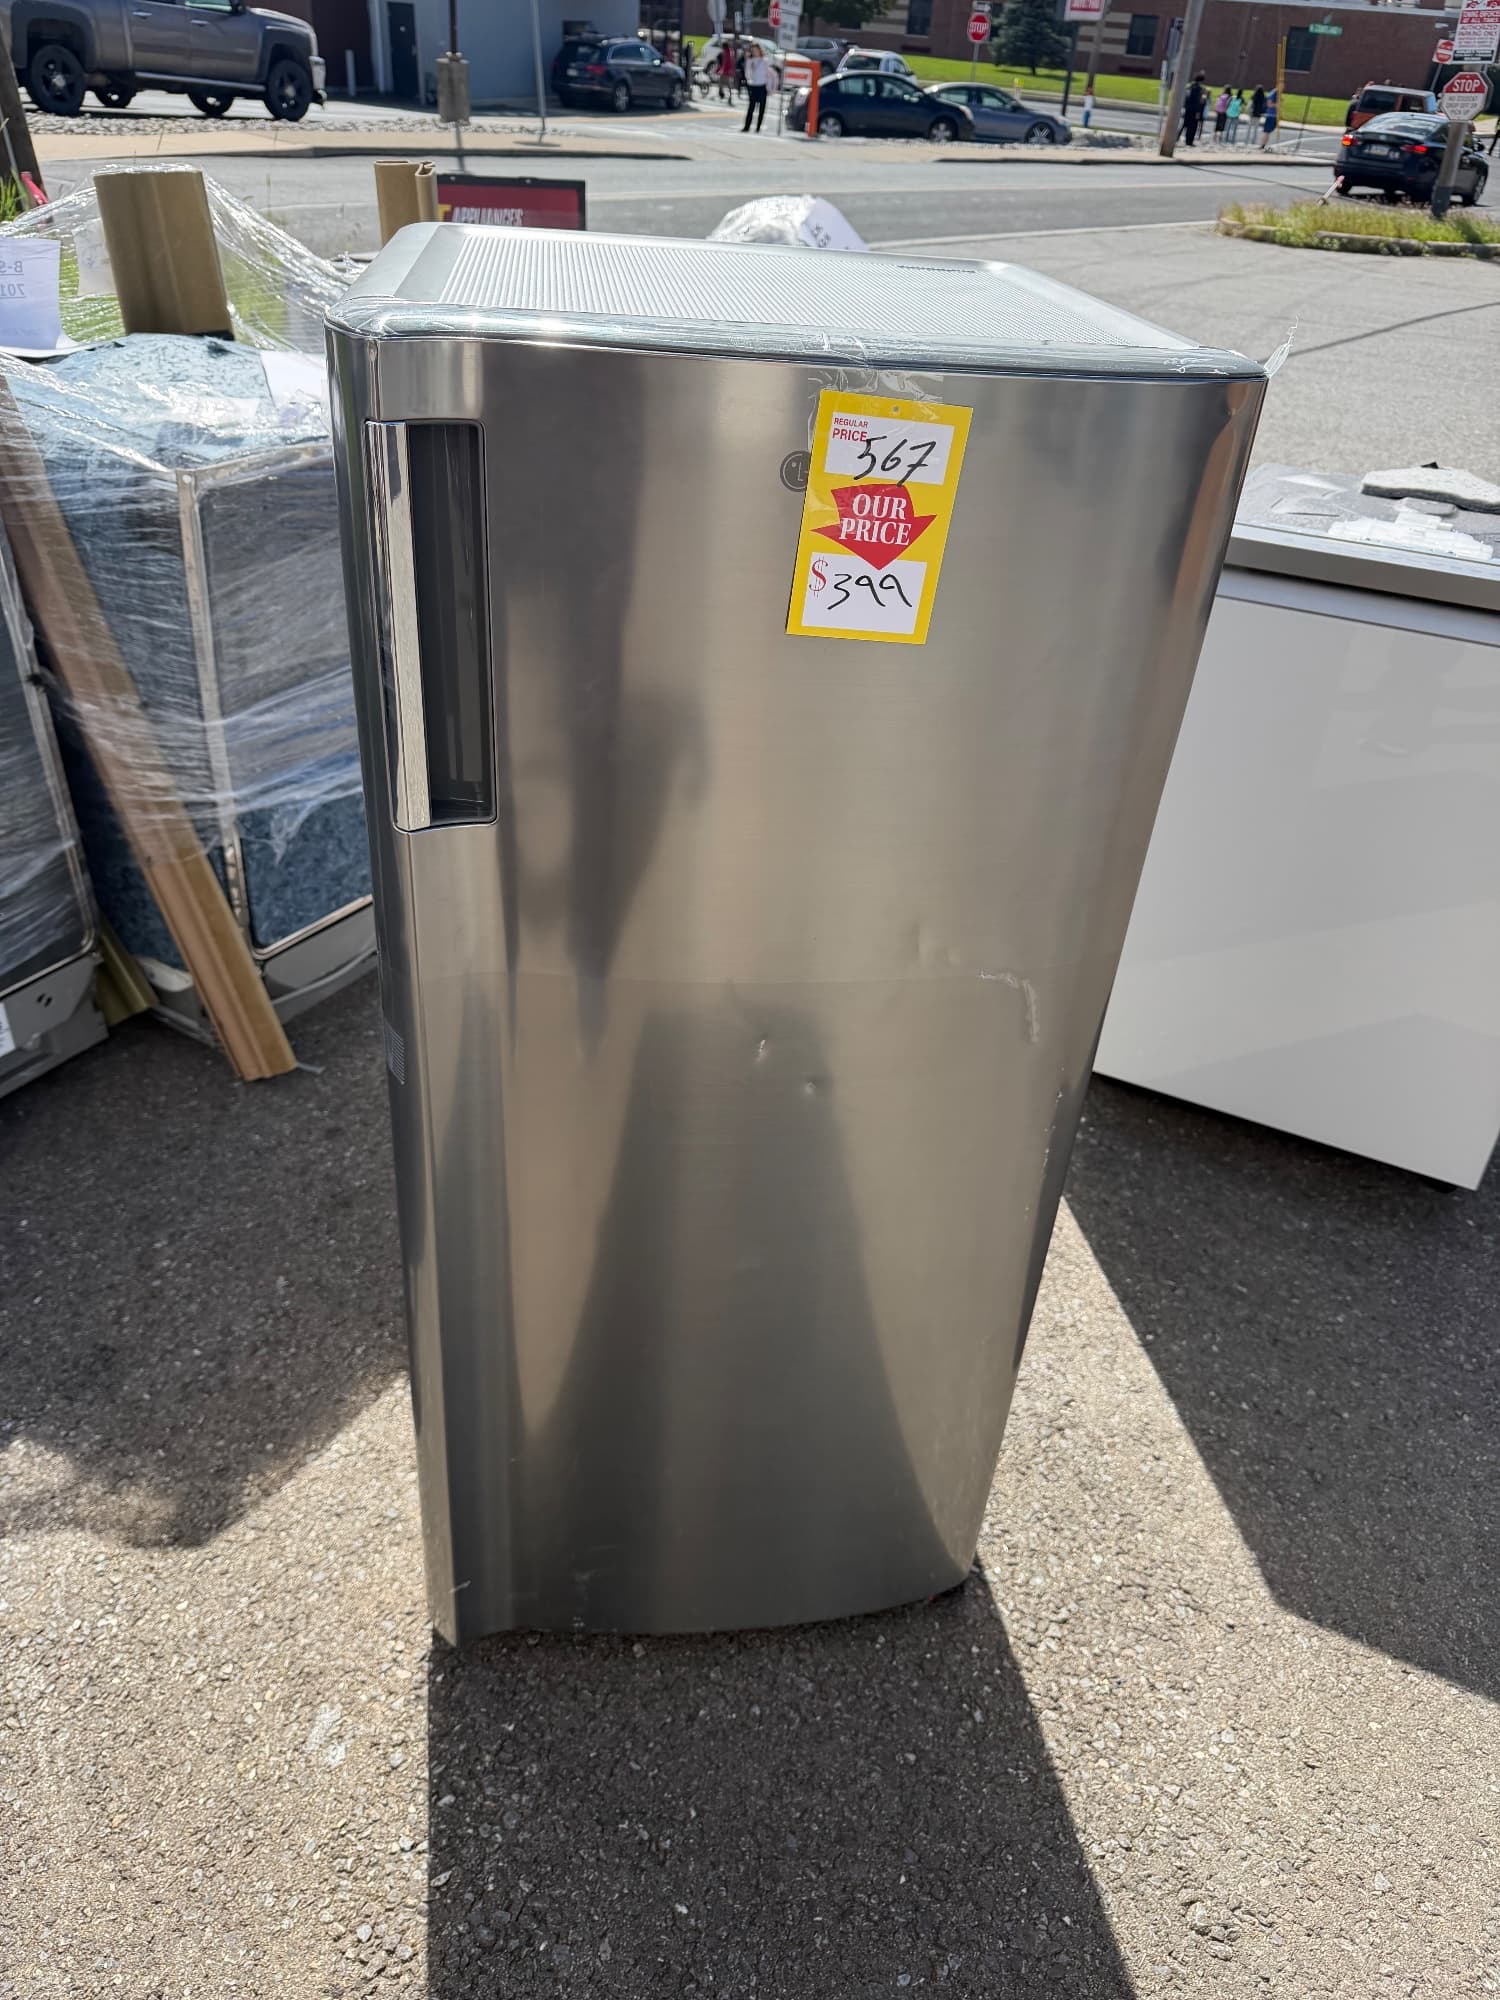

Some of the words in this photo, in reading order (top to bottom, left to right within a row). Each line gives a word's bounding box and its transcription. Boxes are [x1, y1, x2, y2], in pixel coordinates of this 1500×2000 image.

[1452, 79, 1480, 92] STOP
[833, 417, 869, 429] REGULAR
[832, 428, 868, 442] PRICE
[853, 436, 937, 487] 567
[852, 493, 907, 520] OUR
[838, 518, 912, 546] PRICE
